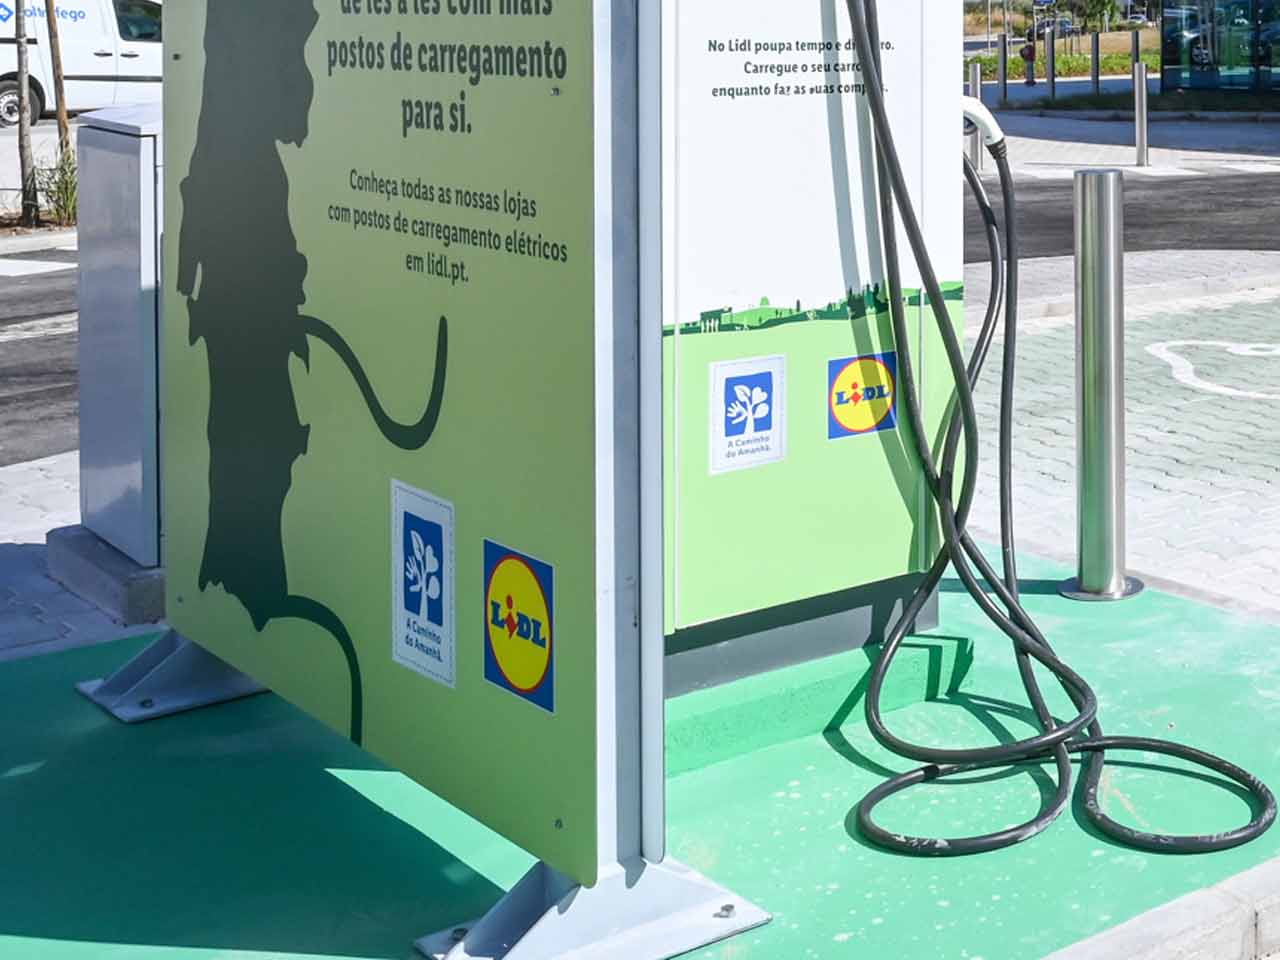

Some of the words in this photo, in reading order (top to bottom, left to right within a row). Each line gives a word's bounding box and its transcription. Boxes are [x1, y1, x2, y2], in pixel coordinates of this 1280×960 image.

[327, 36, 385, 77] postos
[390, 32, 413, 71] de
[418, 40, 567, 86] carregamento
[708, 40, 725, 52] No
[728, 39, 751, 52] Lidl
[754, 40, 792, 54] poupa
[795, 40, 832, 54] tempo
[835, 41, 842, 51] e
[744, 61, 798, 77] Carregue
[801, 63, 808, 72] o
[811, 63, 831, 73] seu
[711, 84, 771, 99] enquanto
[793, 85, 806, 95] as
[401, 98, 444, 138] para
[449, 90, 472, 134] si.
[350, 168, 398, 200] Conheça
[401, 177, 435, 202] todas
[438, 186, 451, 204] as
[455, 188, 500, 212] nossas
[504, 189, 537, 221] lojas
[327, 203, 350, 223] com
[353, 206, 391, 231] postos
[393, 211, 409, 234] de
[411, 218, 501, 248] carregamento
[505, 229, 568, 263] elétricos
[406, 252, 424, 273] em
[427, 251, 469, 286] lidl.pt.
[728, 440, 734, 448] A
[406, 617, 411, 630] A
